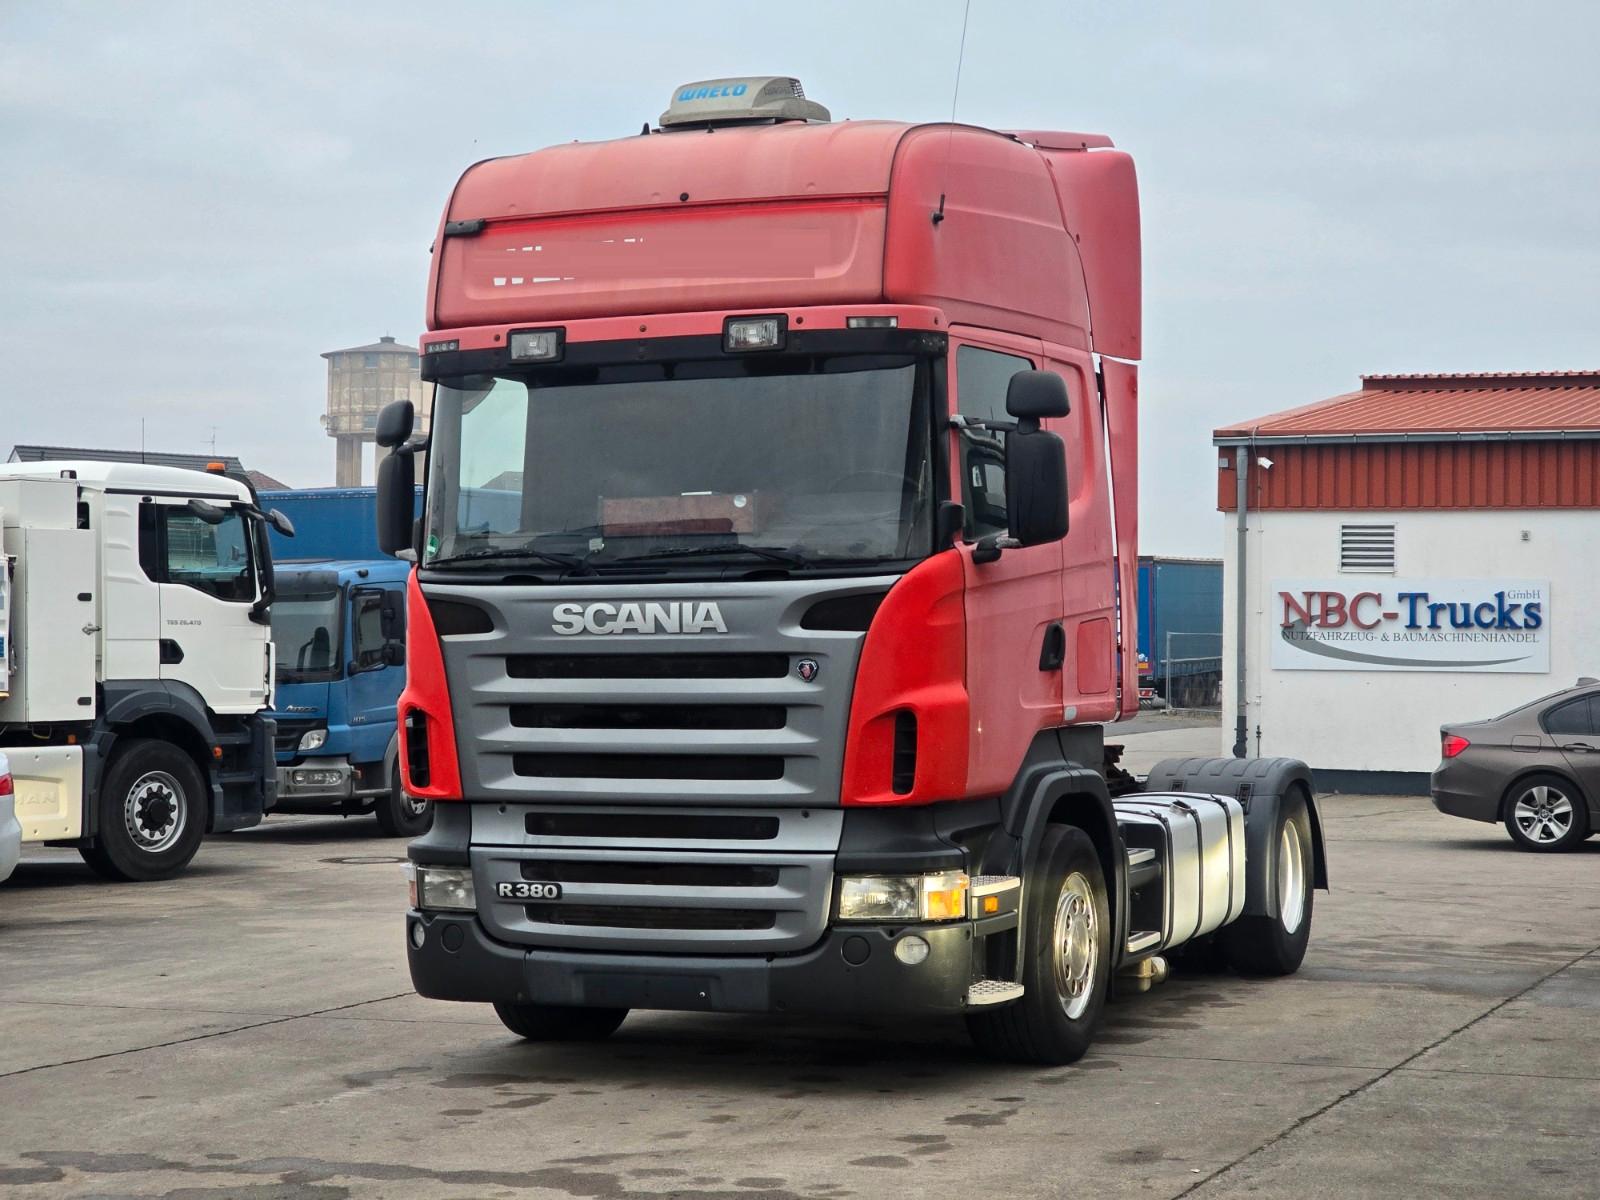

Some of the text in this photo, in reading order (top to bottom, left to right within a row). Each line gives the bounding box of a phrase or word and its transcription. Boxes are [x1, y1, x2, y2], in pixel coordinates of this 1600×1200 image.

[678, 83, 749, 102] WAECO
[551, 602, 728, 635] SCANIA
[1278, 590, 1542, 630] NBC-Trucks GmbH
[1282, 631, 1540, 643] NUTZFAHRZEUG- & BAUMASCHINENHANDEL
[499, 883, 558, 898] R 380
